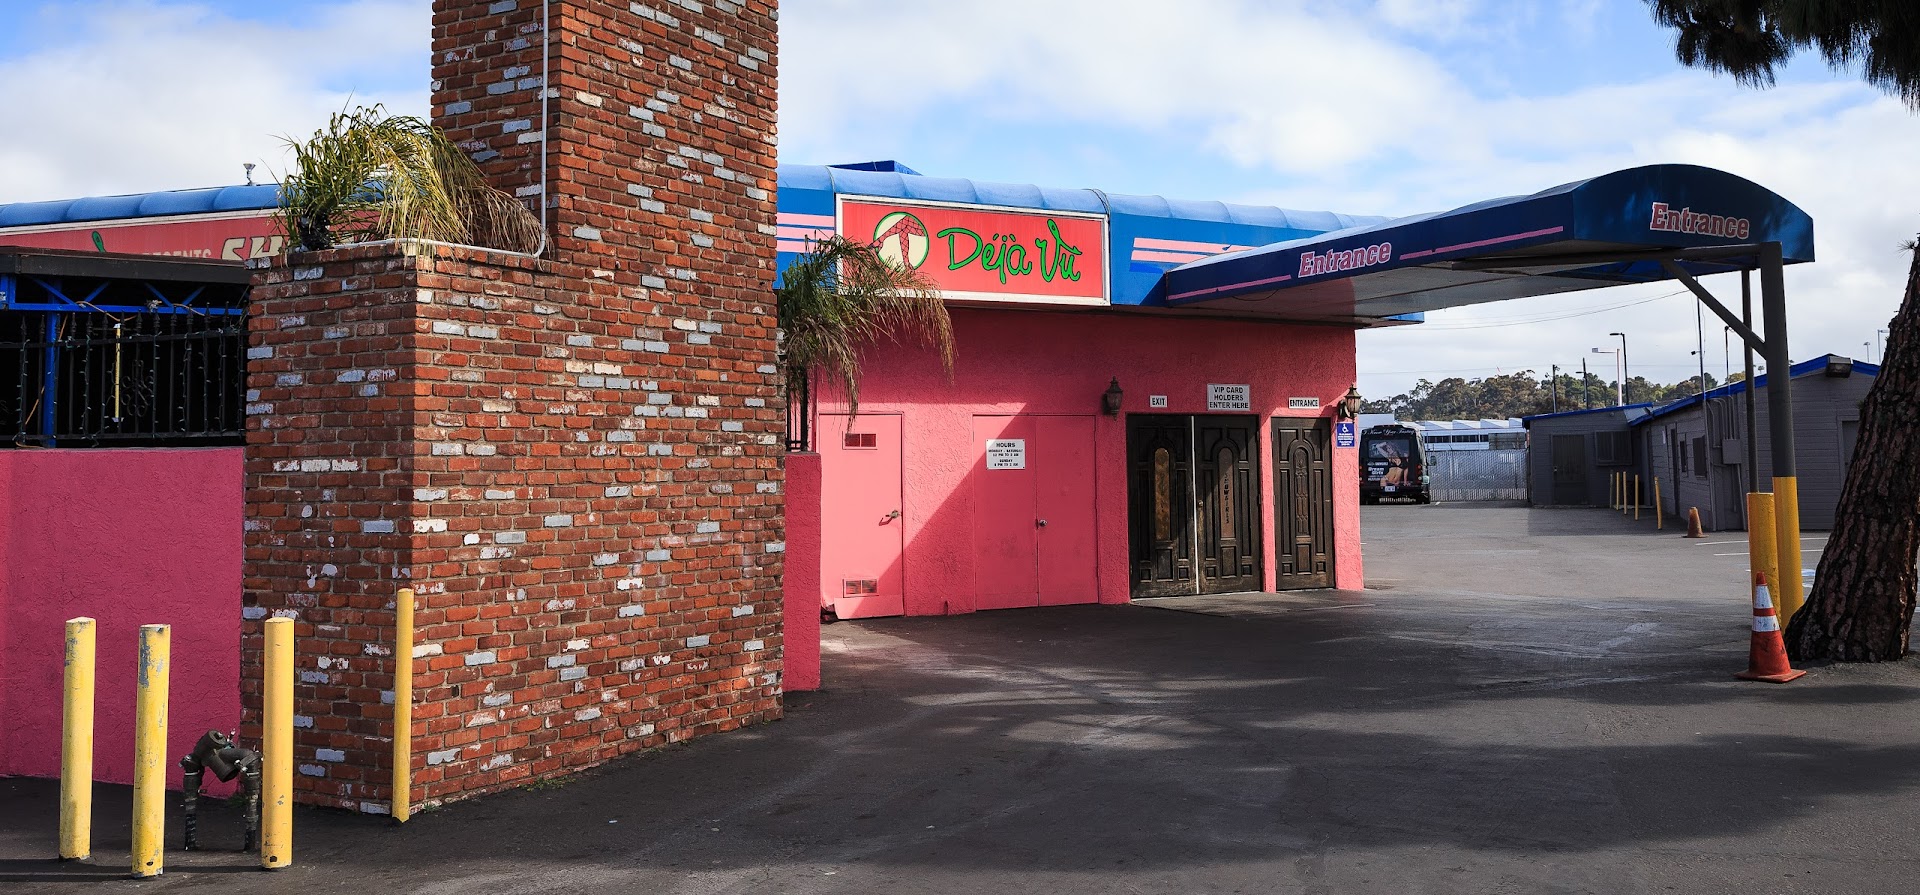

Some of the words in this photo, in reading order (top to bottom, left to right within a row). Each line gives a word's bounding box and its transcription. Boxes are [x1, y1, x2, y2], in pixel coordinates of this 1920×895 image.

[1649, 201, 1750, 240] Entrance
[936, 227, 1033, 285] Déjà
[1035, 218, 1083, 283] Vu
[1297, 241, 1392, 278] Entrance
[1213, 386, 1225, 394] VIP
[1226, 386, 1244, 394] CARD
[1151, 397, 1166, 406] EXIT
[1209, 401, 1231, 409] ENTER
[1289, 399, 1319, 407] ENTRANCE
